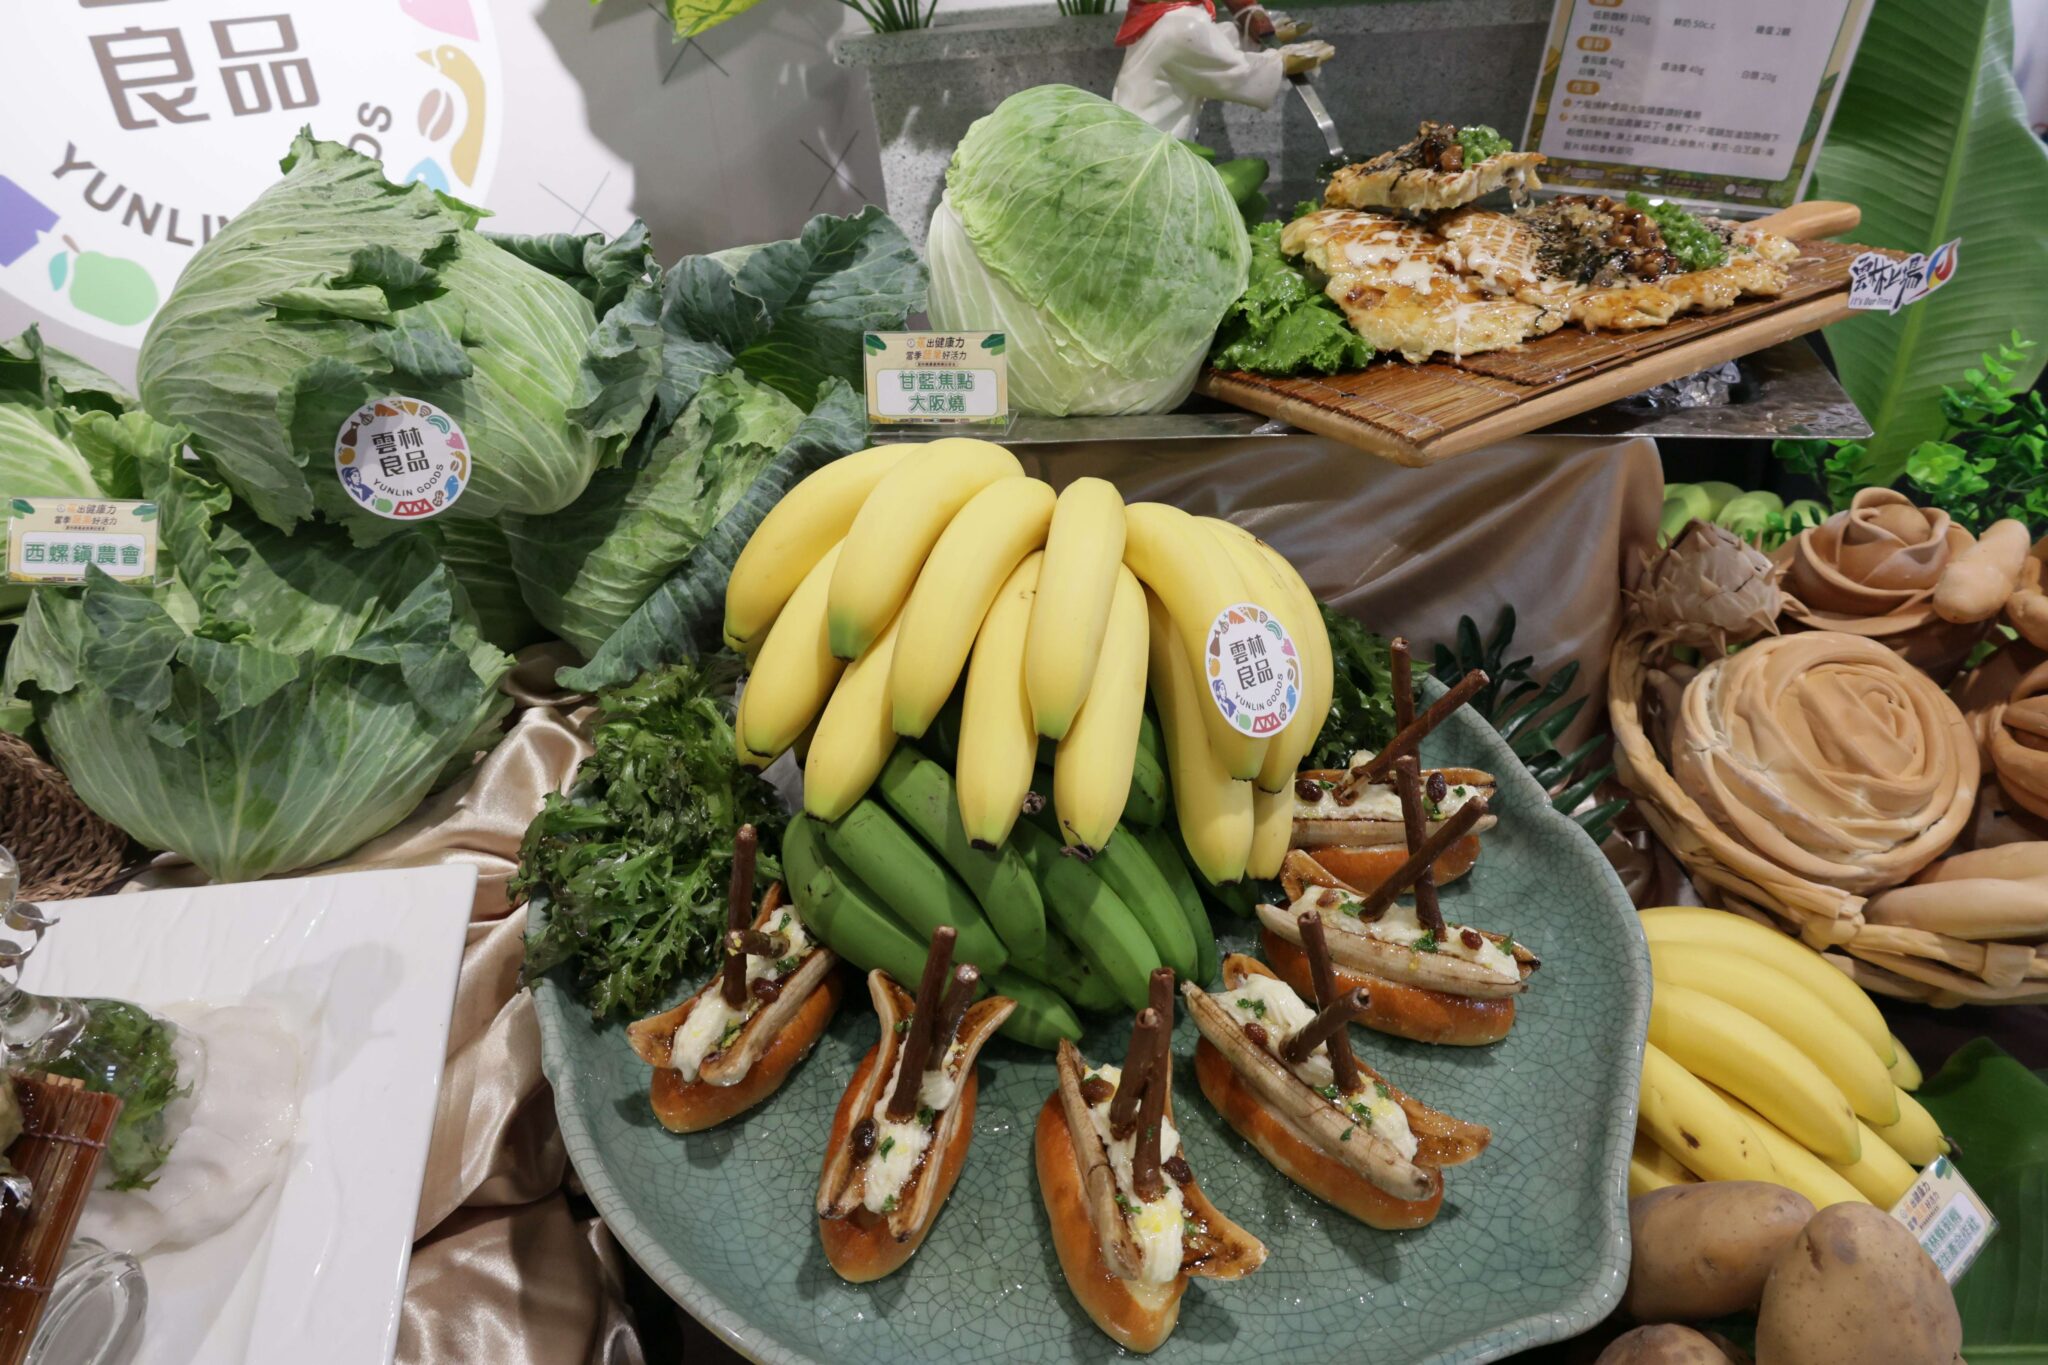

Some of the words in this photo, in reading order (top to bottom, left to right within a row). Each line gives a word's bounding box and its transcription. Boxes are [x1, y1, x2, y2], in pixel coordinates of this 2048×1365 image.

[88, 13, 320, 131] 良品
[51, 140, 231, 248] YUNLI
[899, 373, 973, 390] 甘藍焦點
[910, 395, 965, 412] 大阪燒
[371, 427, 424, 455] 雲林
[379, 450, 430, 477] 良品
[373, 478, 413, 497] YUNLIN
[416, 463, 444, 494] GOODS
[25, 543, 141, 565] 西螺鎮農會
[1229, 634, 1266, 665] 雲林
[1237, 659, 1274, 690] 良品
[1234, 691, 1265, 711] YUNLIN
[1266, 673, 1283, 707] GOODS
